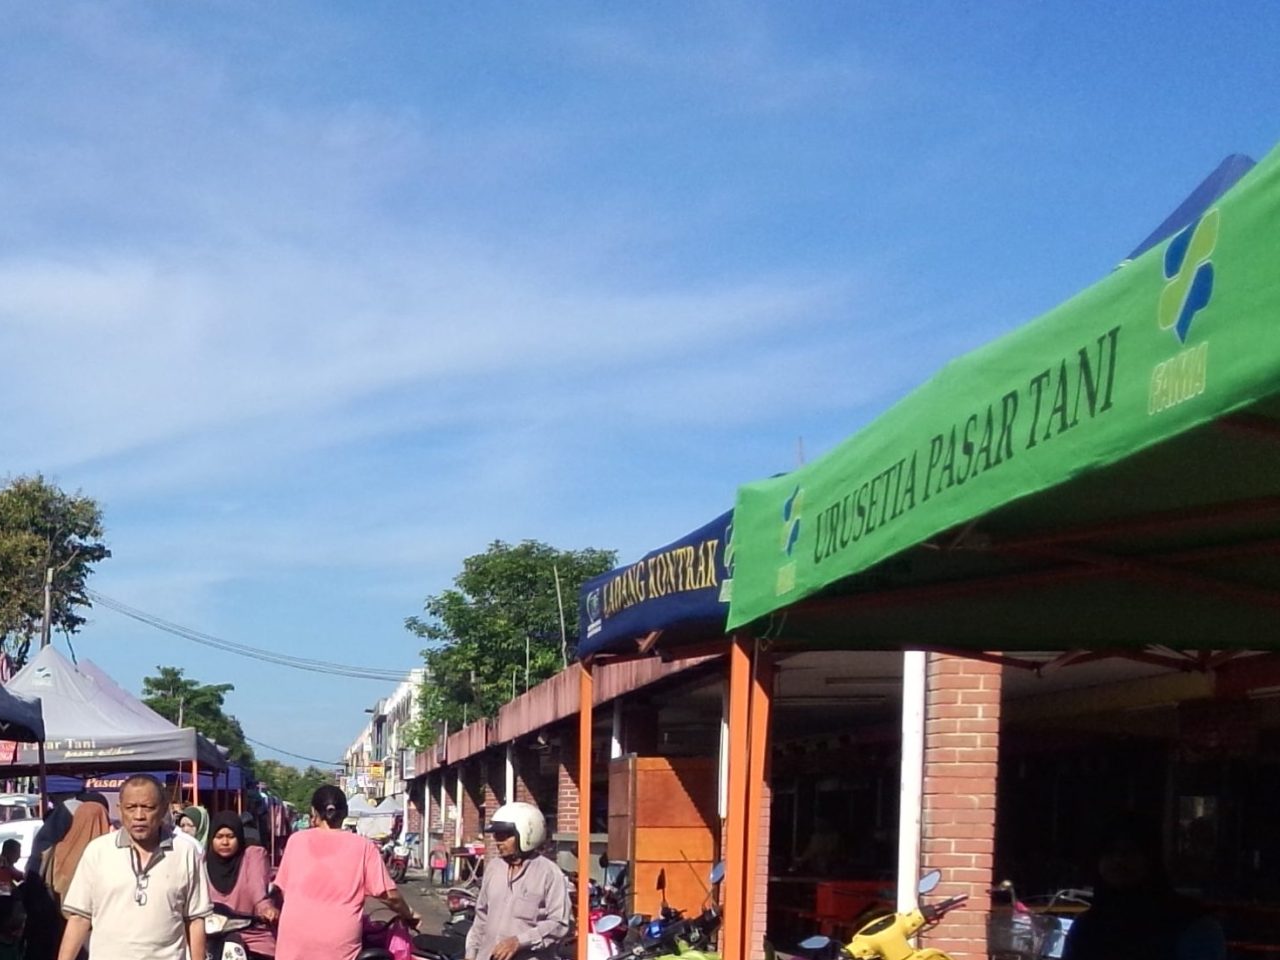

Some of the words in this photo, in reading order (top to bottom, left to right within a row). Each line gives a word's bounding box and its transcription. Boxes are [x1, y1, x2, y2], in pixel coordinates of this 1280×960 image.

[813, 449, 919, 565] URUSETIA
[921, 388, 1019, 502] PASAR
[1024, 324, 1122, 450] TANI
[647, 538, 720, 600] KONTRAK
[85, 778, 125, 789] Pasar
